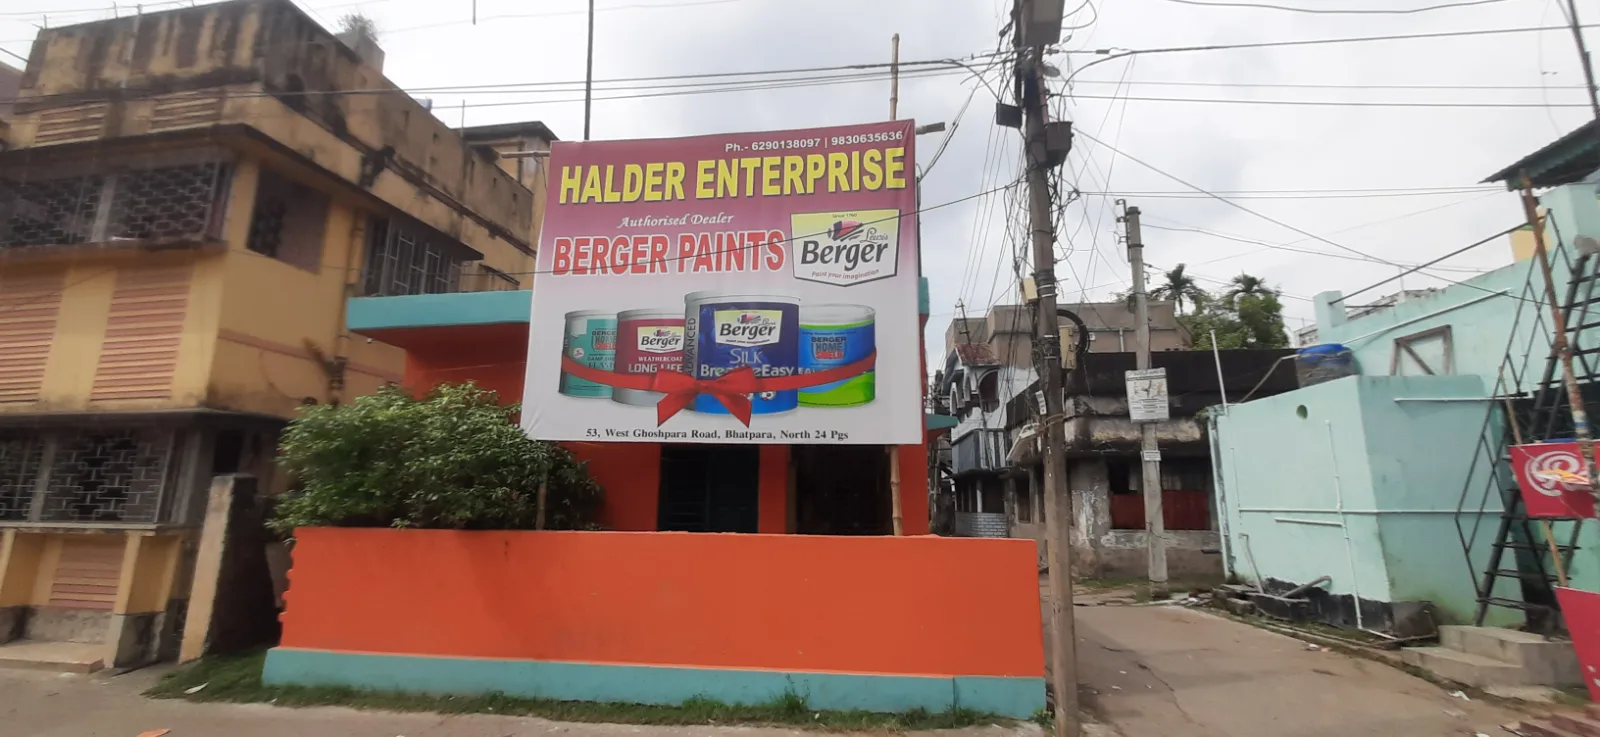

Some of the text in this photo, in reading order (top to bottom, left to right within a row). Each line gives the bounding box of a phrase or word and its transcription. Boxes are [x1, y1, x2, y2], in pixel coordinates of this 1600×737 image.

[751, 138, 821, 151] 6290138097
[831, 131, 903, 146] 9830635636
[559, 147, 906, 204] HALDER ENTERPRISE
[617, 212, 734, 228] Authorised Dealer
[552, 230, 786, 277] BERGER PAINTS
[801, 240, 888, 271] Berger
[719, 323, 777, 340] Berger
[640, 336, 682, 349] Berger
[686, 317, 697, 376] ADVANCED
[628, 364, 658, 373] LONG
[701, 364, 794, 377] BreeEasy
[586, 428, 849, 441] 53, West Ghoshpara Road, Bhatpara, North 24 Pgs
